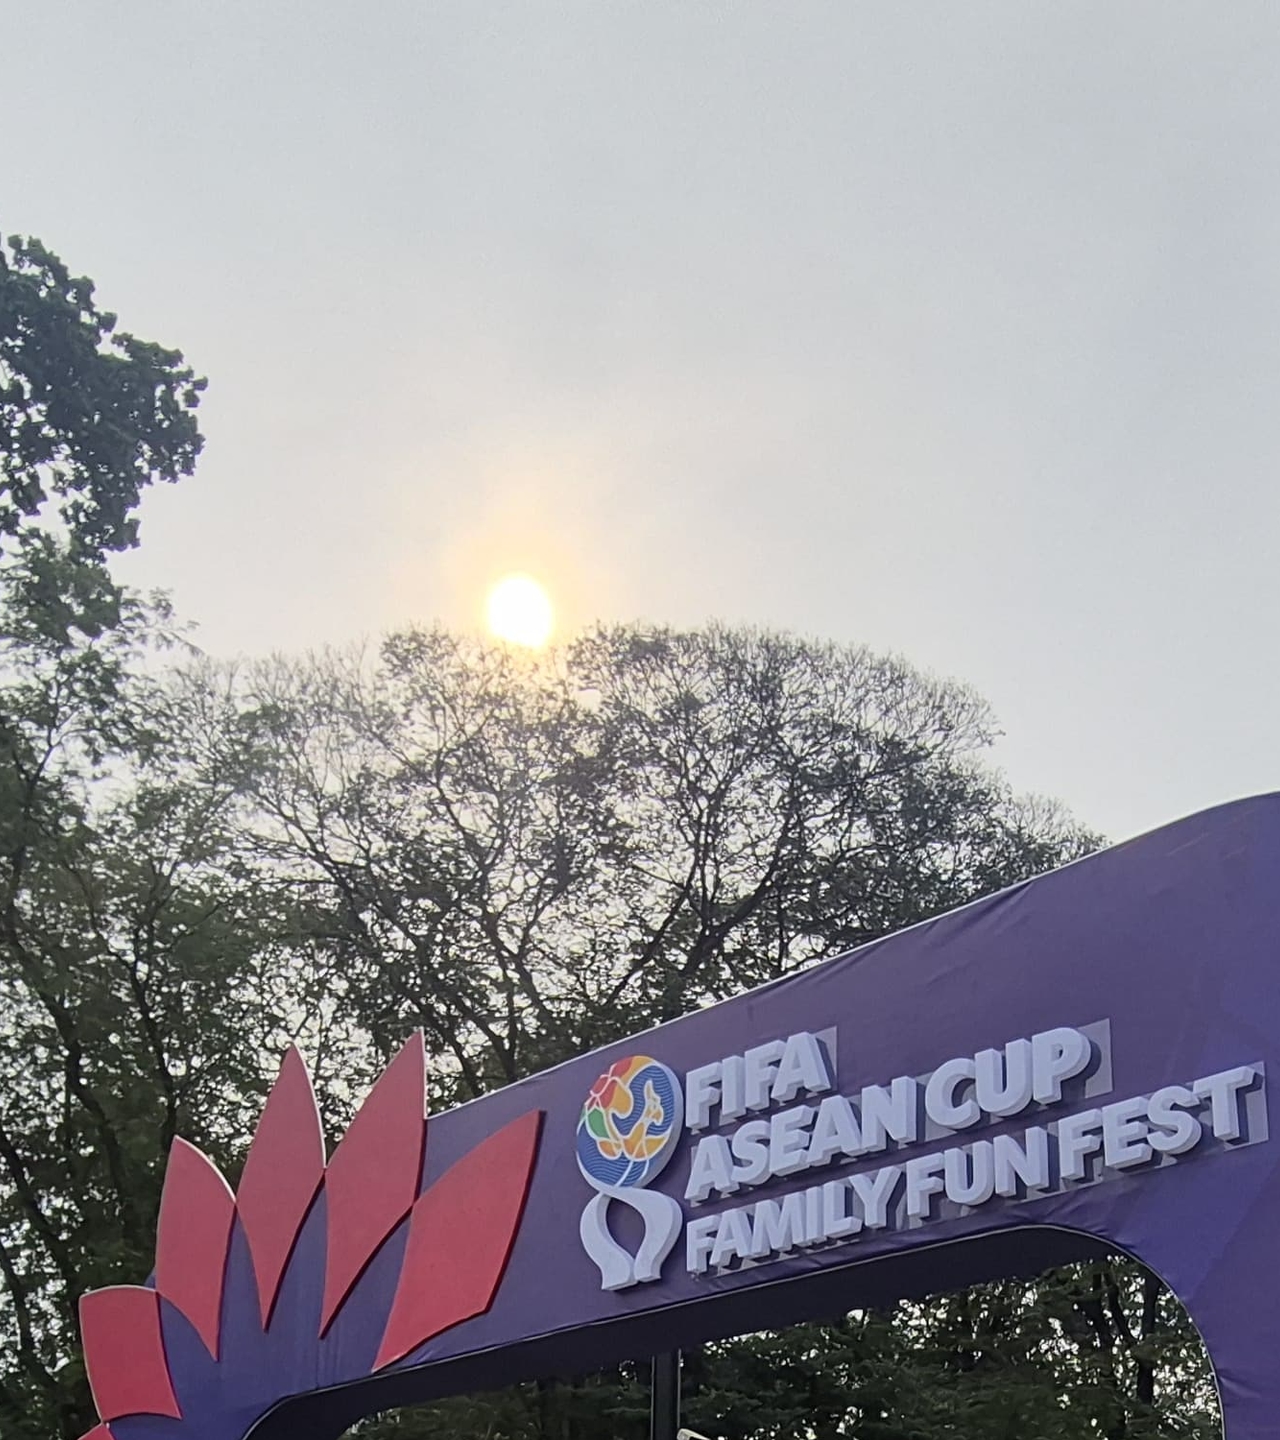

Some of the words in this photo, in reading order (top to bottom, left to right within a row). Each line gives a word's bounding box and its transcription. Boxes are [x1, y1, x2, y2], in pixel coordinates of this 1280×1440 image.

[684, 1076, 917, 1200] ASEAN
[925, 1027, 1091, 1130] CUP
[686, 1031, 832, 1129] FIFA
[686, 1165, 903, 1273] FAMILY
[906, 1126, 1049, 1218] FUN
[1058, 1066, 1256, 1180] FEST
